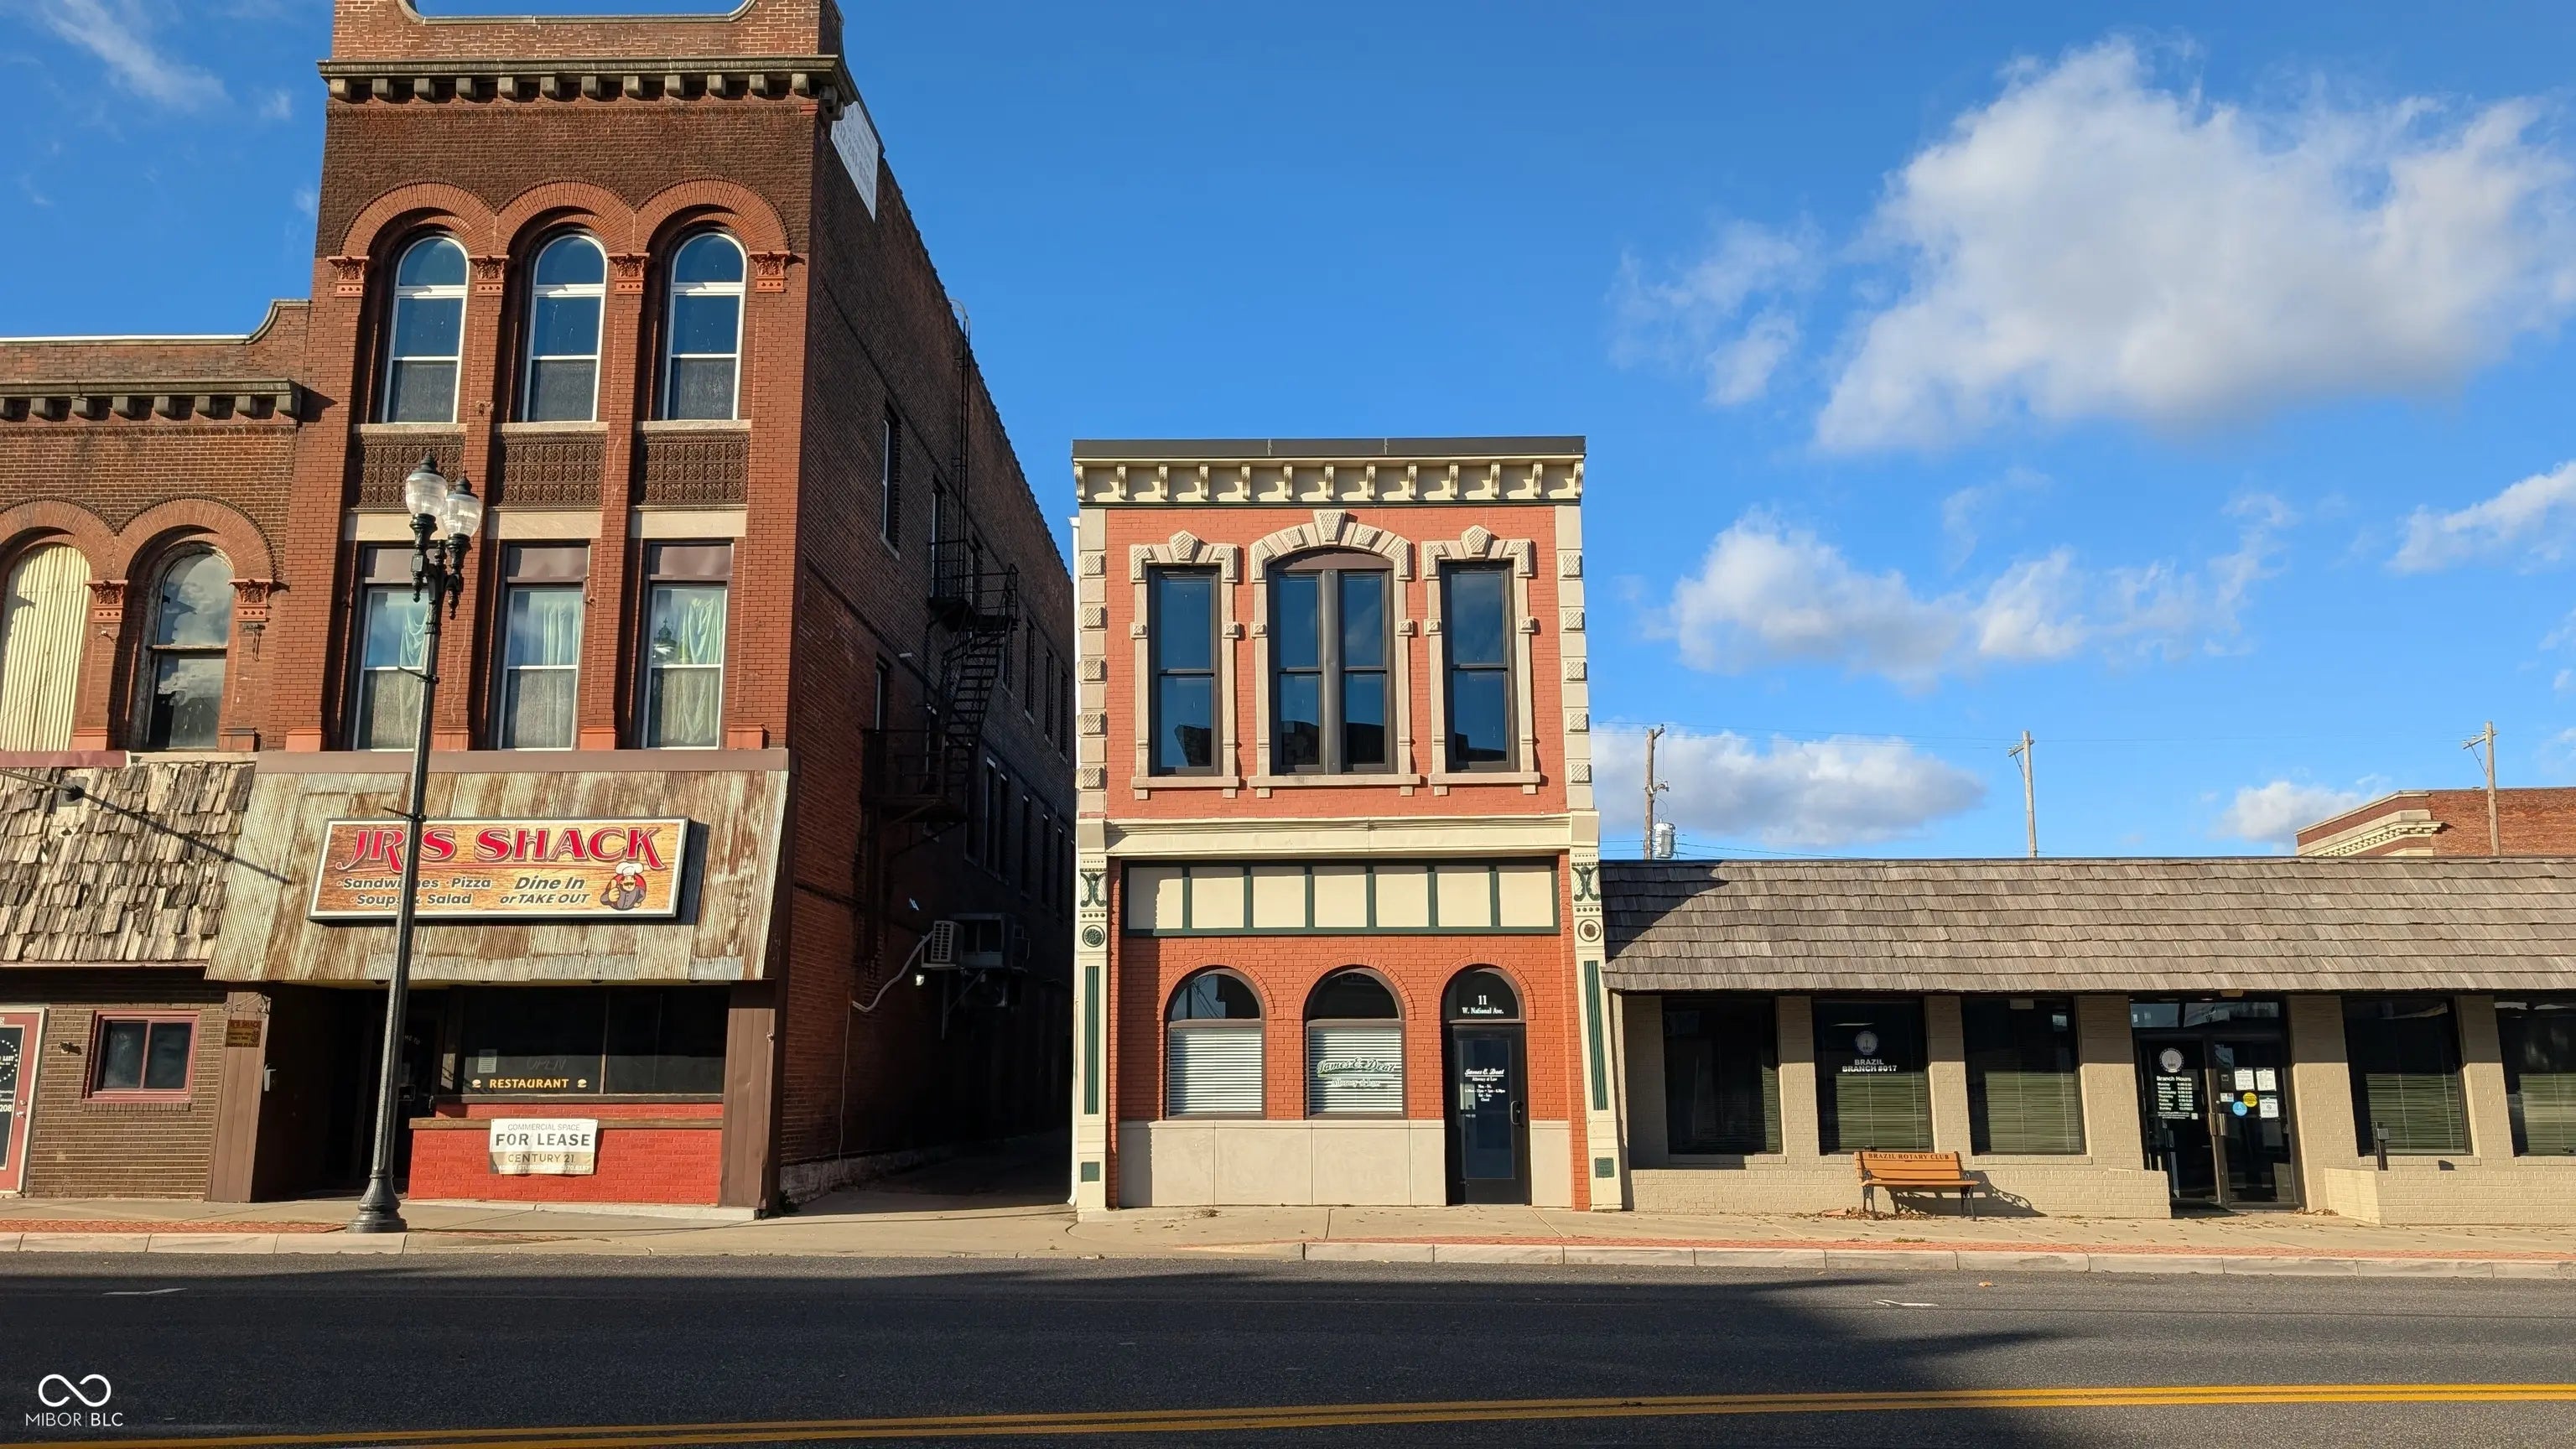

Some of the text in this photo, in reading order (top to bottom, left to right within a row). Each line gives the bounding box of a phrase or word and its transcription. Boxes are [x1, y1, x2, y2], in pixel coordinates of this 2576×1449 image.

[475, 826, 667, 871] SHACK
[344, 876, 491, 889] Sandwies Pizza
[514, 875, 585, 890] Dine In
[427, 893, 472, 905] Salad
[500, 894, 590, 904] or TAKE OUT
[1478, 995, 1488, 1005] 11
[1317, 1059, 1352, 1073] James
[1366, 1058, 1396, 1072] Deal
[489, 1078, 569, 1088] RESTAURANT
[496, 1133, 591, 1146] FOR LEASE
[507, 1154, 574, 1163] CENTURY 21
